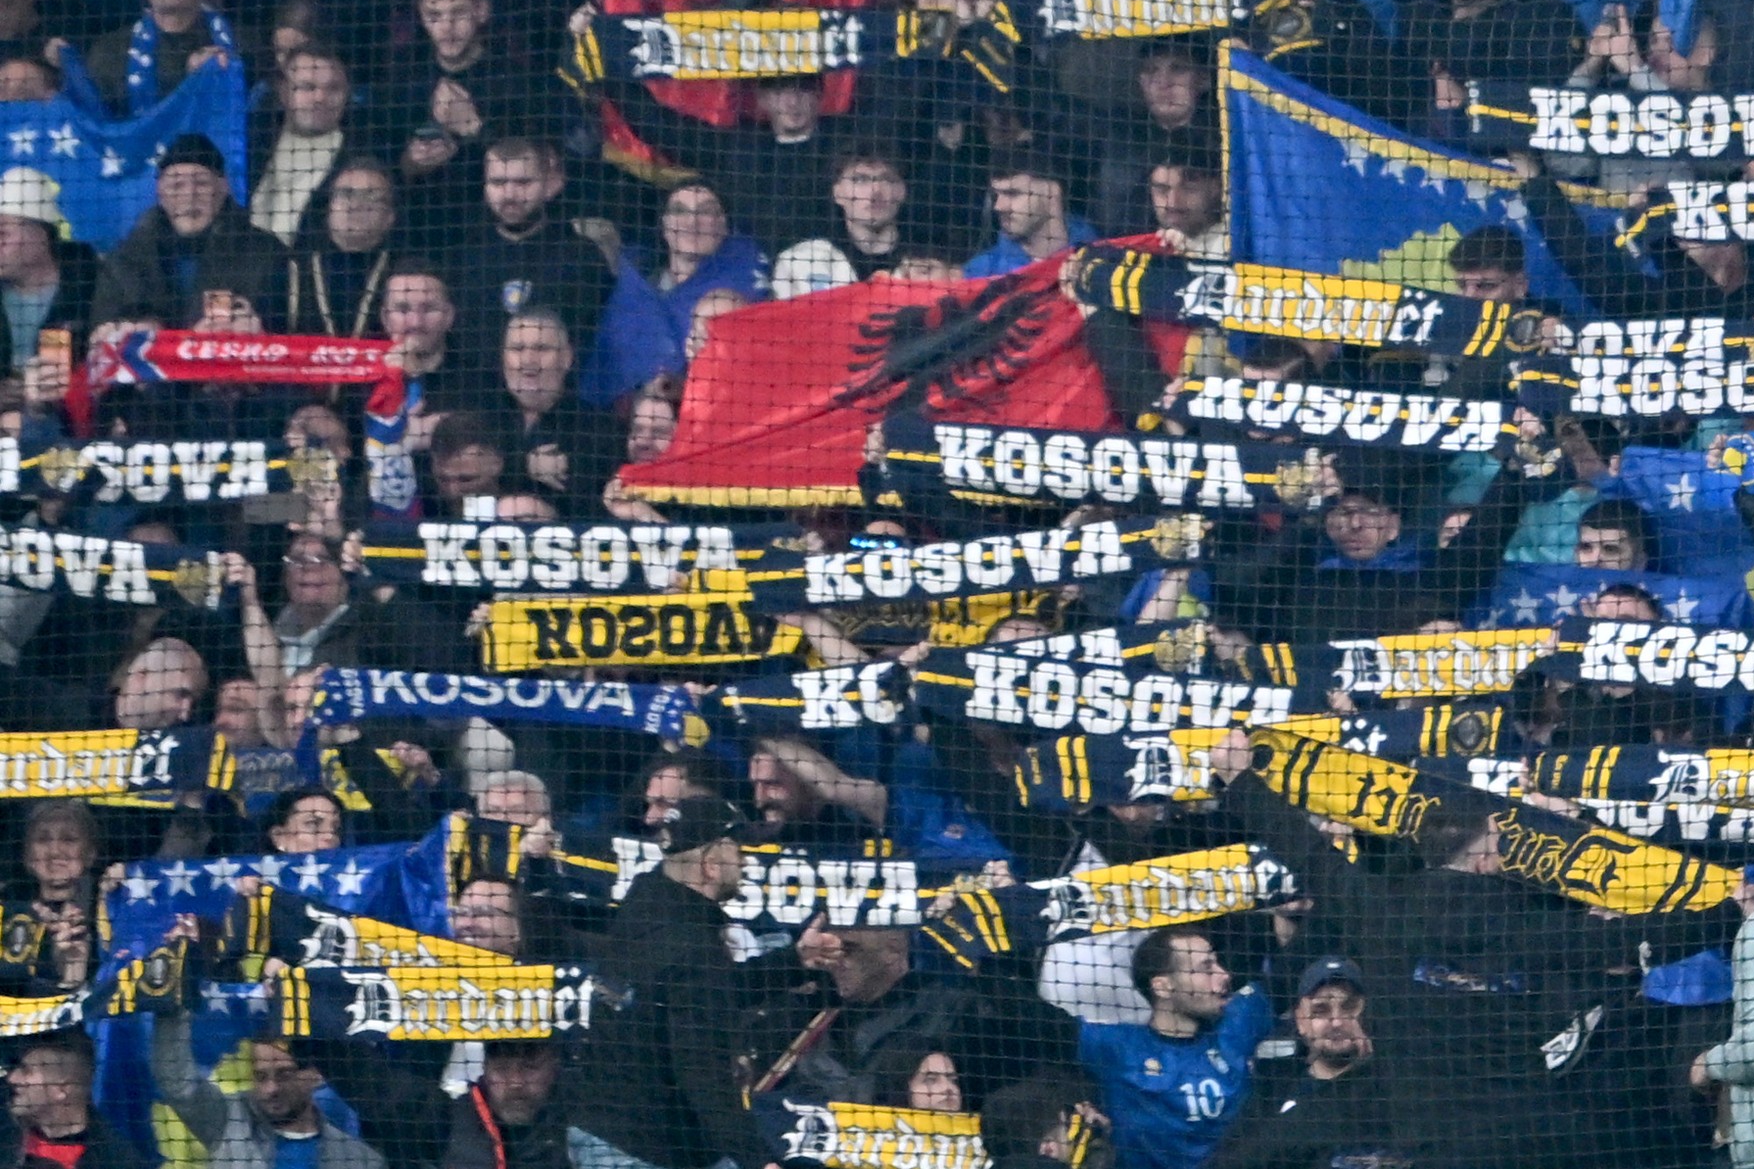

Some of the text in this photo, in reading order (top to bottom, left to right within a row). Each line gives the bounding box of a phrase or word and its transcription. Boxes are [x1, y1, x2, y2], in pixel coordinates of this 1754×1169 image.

[1178, 260, 1444, 345] Dardanët
[933, 423, 1253, 508] KOSOVA
[803, 519, 1132, 604] KOSOVA
[343, 965, 597, 1034] Dardanët
[1178, 1079, 1224, 1123] 10
